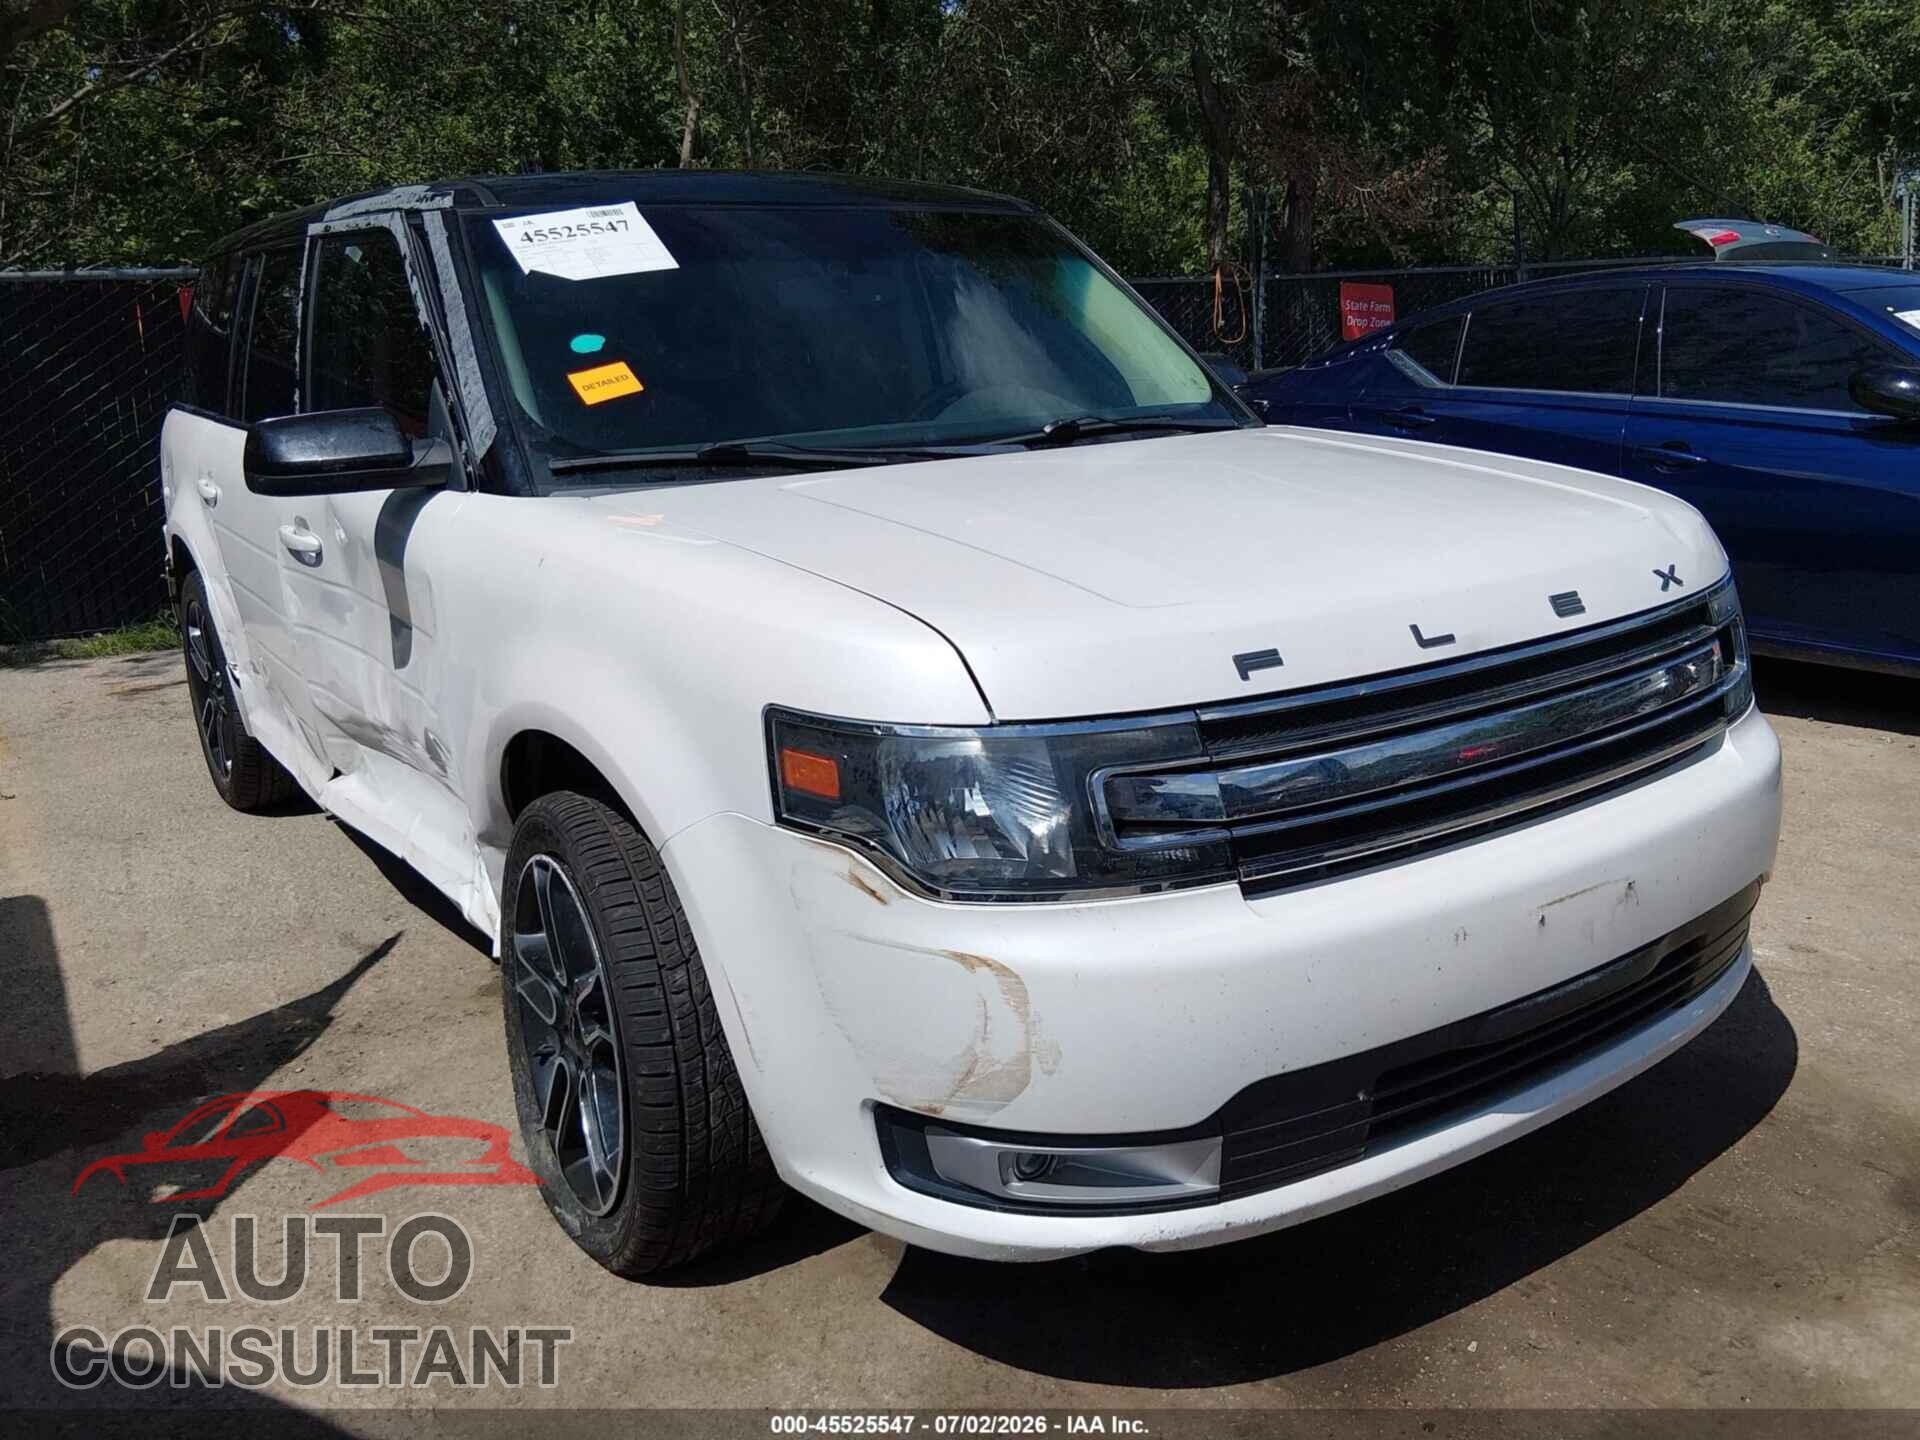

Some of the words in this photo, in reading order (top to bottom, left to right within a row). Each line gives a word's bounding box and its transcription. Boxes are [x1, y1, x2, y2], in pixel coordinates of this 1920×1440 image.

[520, 219, 629, 243] 45525547
[1345, 299, 1368, 311] State
[1370, 301, 1391, 313] Farm
[1347, 315, 1368, 328] Drop
[581, 374, 629, 392] DETAILED
